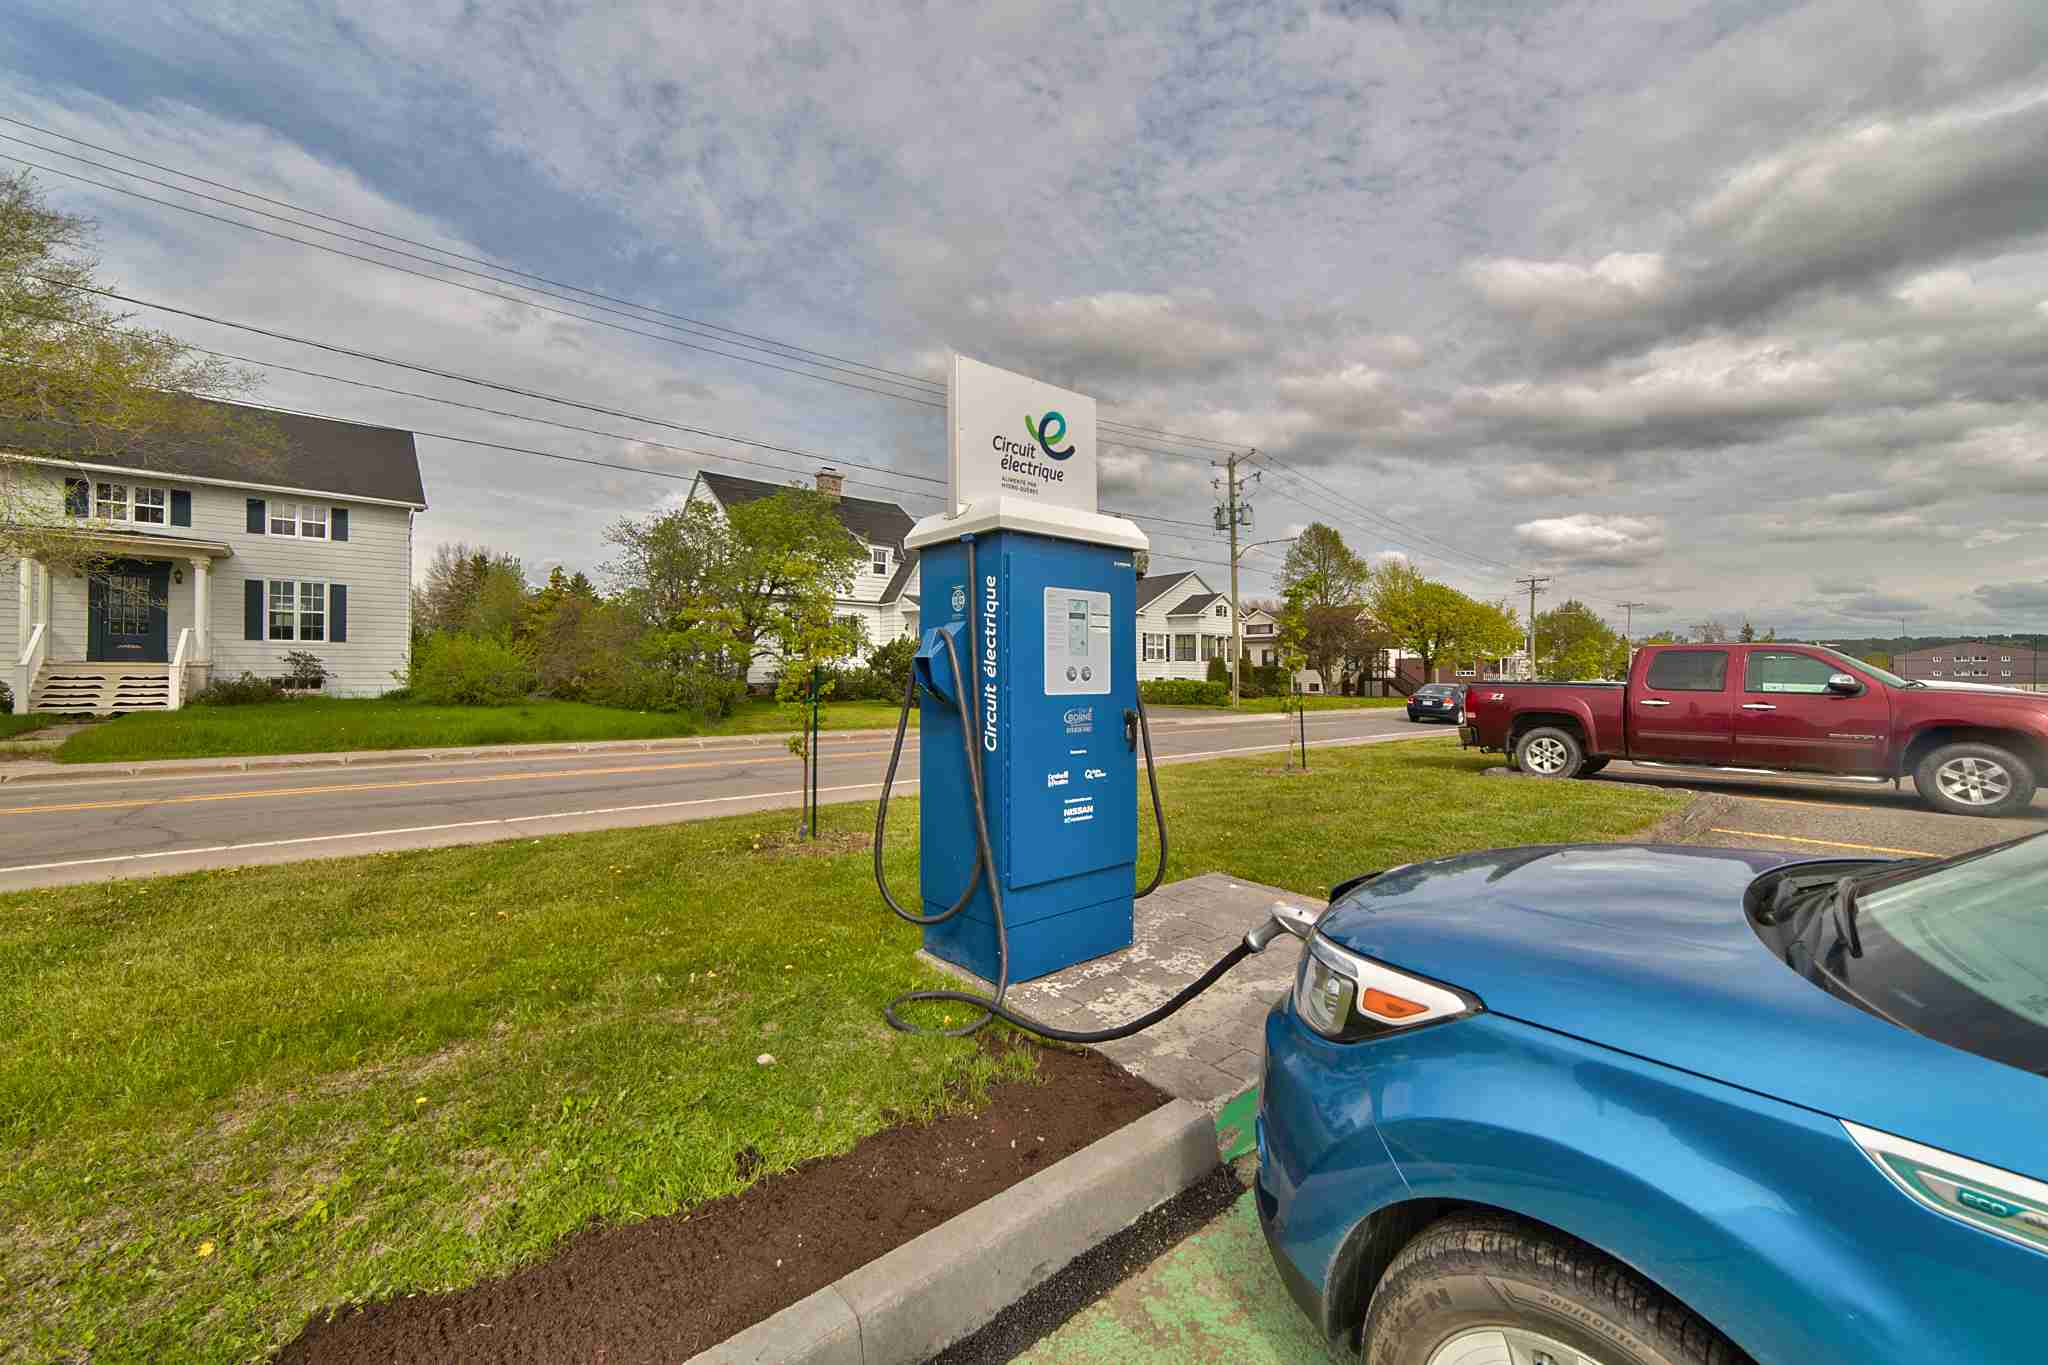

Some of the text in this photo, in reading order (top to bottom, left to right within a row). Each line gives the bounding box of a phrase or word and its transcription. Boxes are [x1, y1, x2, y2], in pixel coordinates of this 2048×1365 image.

[992, 435, 1037, 459] Circuit
[1000, 454, 1064, 483] électrique
[984, 575, 1001, 752] Circuit électrique
